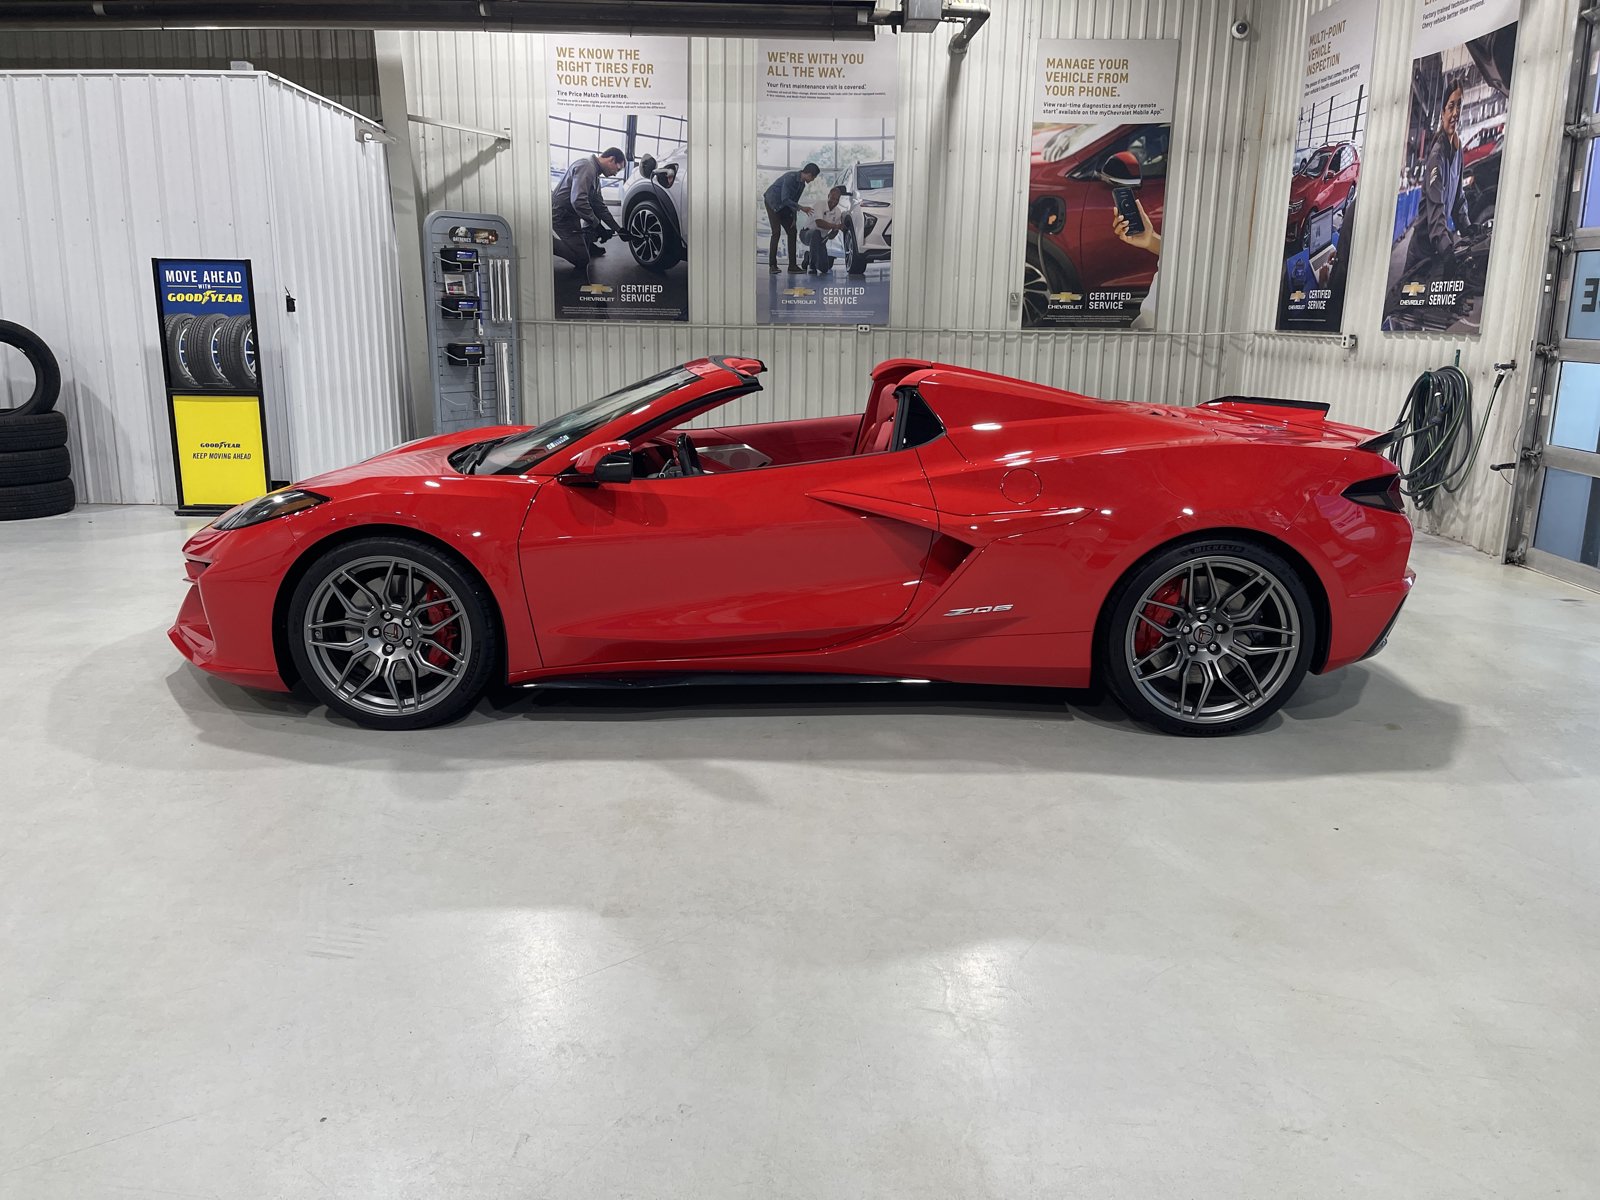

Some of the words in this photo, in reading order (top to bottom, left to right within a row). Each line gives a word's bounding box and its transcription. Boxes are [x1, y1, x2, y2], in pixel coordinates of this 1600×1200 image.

[1309, 20, 1346, 47] MULTI-POINT
[556, 46, 574, 58] WE
[579, 48, 613, 59] KNOW
[617, 49, 640, 60] THE
[1308, 41, 1331, 61] VEHICLE
[767, 52, 804, 64] WE'RE
[808, 53, 838, 64] WITH
[842, 54, 864, 64] YOU
[1046, 58, 1095, 70] MANAGE
[1099, 59, 1128, 70] YOUR
[1306, 52, 1340, 76] INSPECTION
[557, 61, 591, 72] RIGHT
[595, 62, 628, 73] TIRES
[632, 64, 654, 74] FOR
[767, 66, 789, 76] ALL
[792, 66, 814, 77] THE
[818, 67, 845, 78] WAY.
[557, 74, 588, 86] YOUR
[591, 76, 630, 88] CHEVY
[634, 78, 651, 88] EV.
[1046, 72, 1093, 83] VEHICLE
[1097, 72, 1128, 83] FROM
[1045, 85, 1074, 96] YOUR
[1079, 86, 1120, 97] PHONE.
[165, 270, 197, 282] MOVE
[204, 271, 241, 283] AHEAD
[621, 285, 663, 293] CERTIFIED
[1430, 280, 1464, 292] CERTIFIED
[167, 291, 243, 304] GOODYEAR
[621, 294, 655, 302] SERVICE
[1309, 290, 1331, 298] CERTIFIED
[1428, 294, 1456, 306] SERVICE
[823, 297, 858, 305] SERVICE
[1089, 302, 1123, 310] SERVICE
[1308, 300, 1326, 310] SERVICE
[943, 604, 1014, 616] Z06
